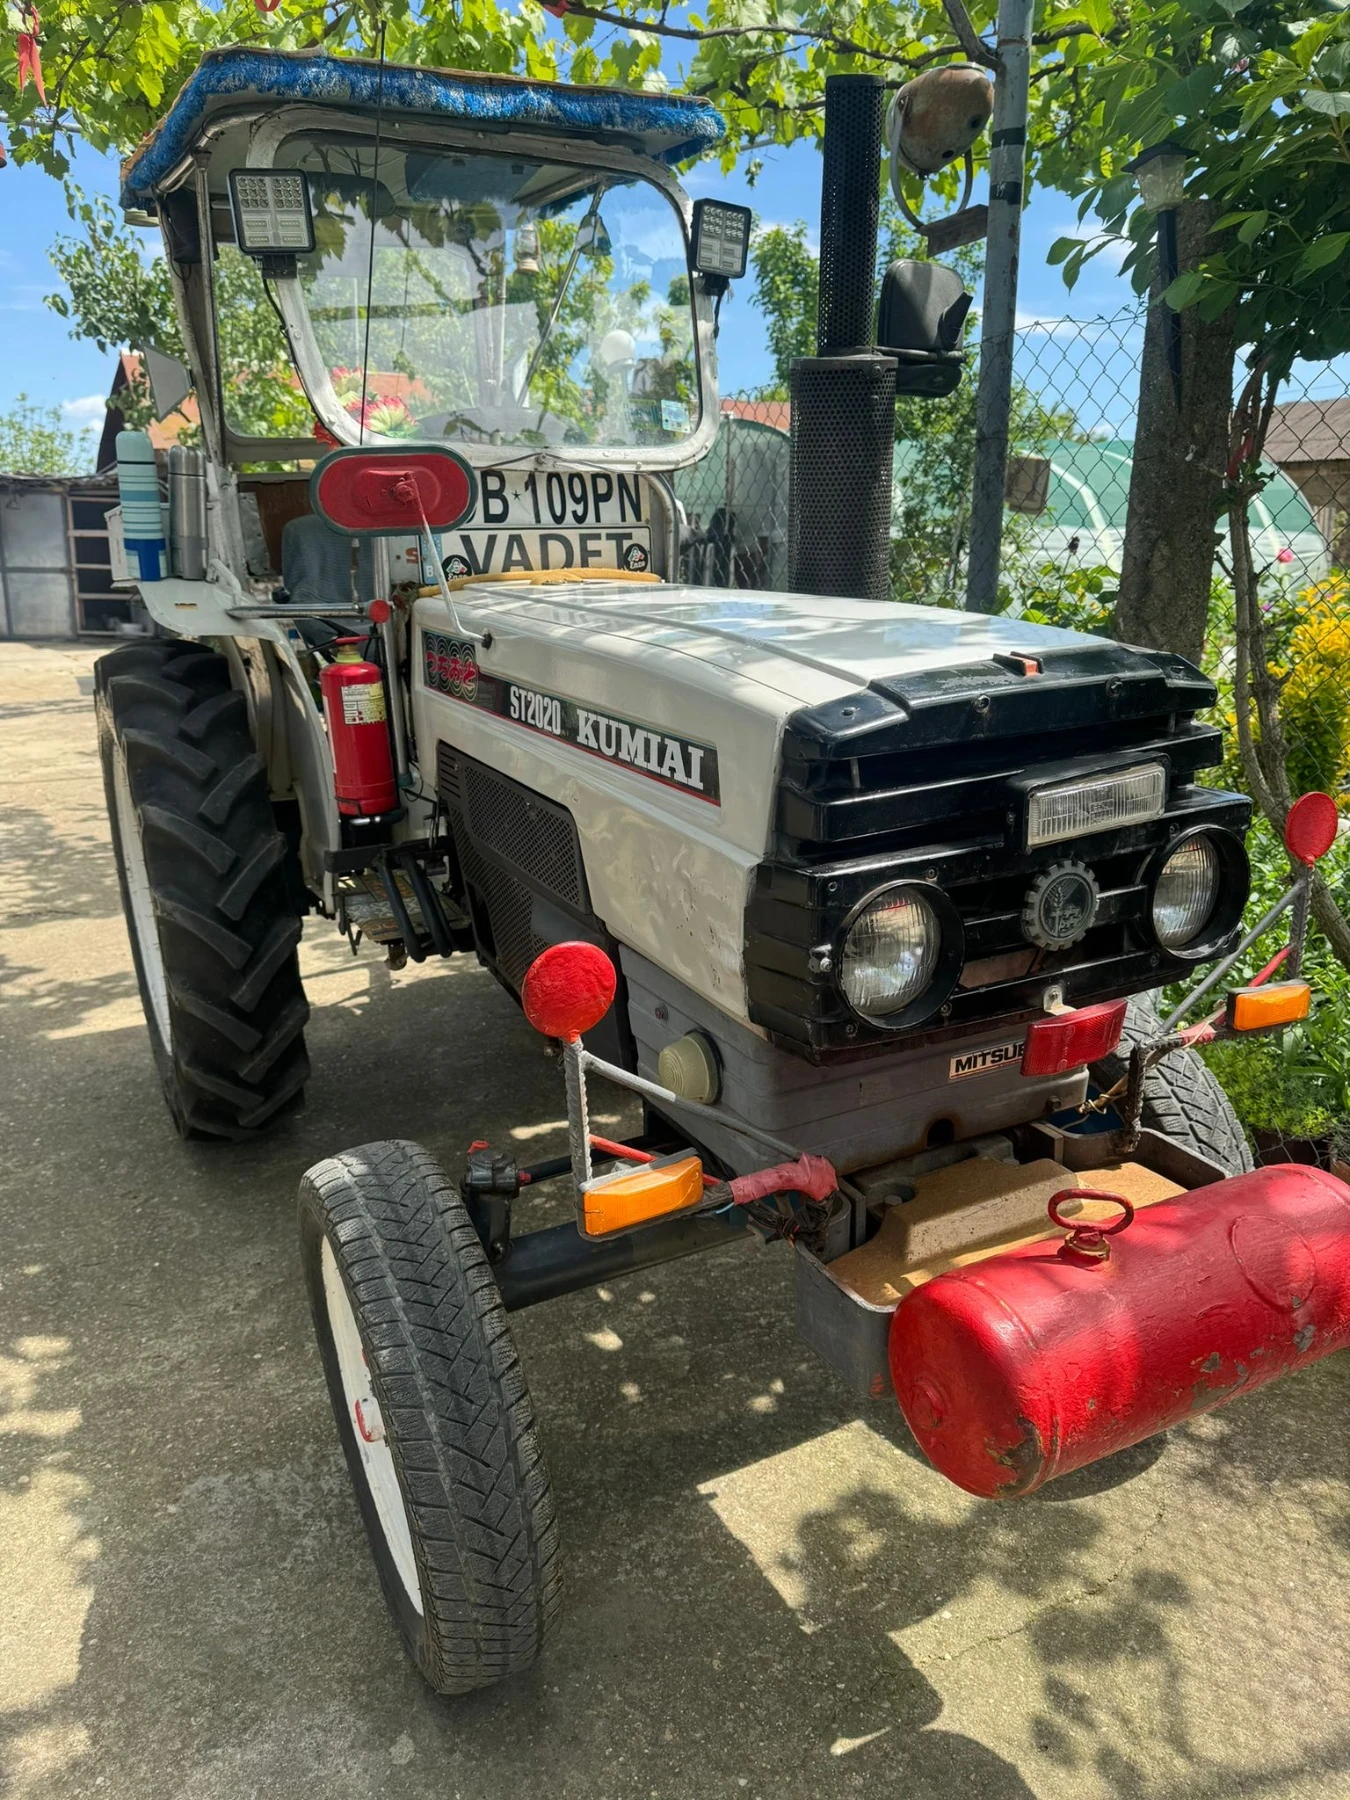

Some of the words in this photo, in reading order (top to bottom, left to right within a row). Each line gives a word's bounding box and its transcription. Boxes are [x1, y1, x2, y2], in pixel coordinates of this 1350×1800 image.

[465, 470, 510, 524] B
[524, 471, 642, 525] 109PN
[425, 565, 434, 578] B
[510, 685, 561, 736] ST2020
[576, 708, 704, 791] KUMIAI
